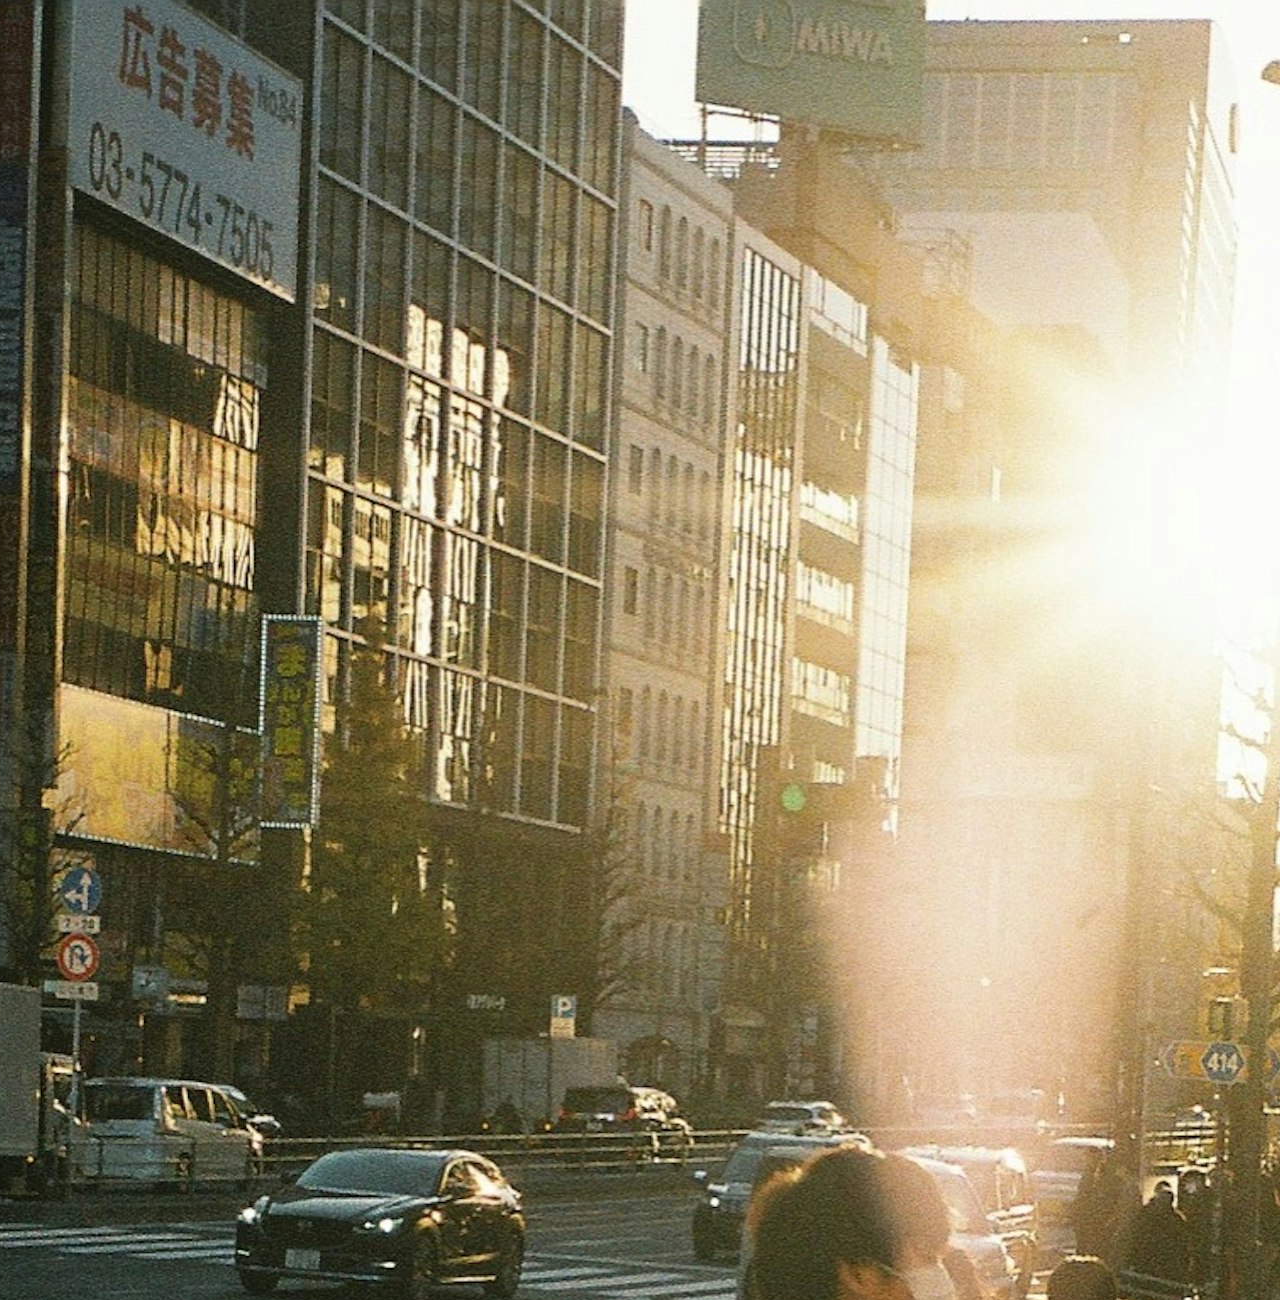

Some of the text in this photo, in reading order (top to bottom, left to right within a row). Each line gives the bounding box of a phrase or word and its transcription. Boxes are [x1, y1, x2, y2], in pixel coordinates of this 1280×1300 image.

[797, 18, 893, 65] MIWA
[120, 5, 254, 161] 広告募集
[89, 121, 274, 281] 03-5774-7505
[558, 997, 572, 1018] P
[1208, 1052, 1239, 1073] 414
